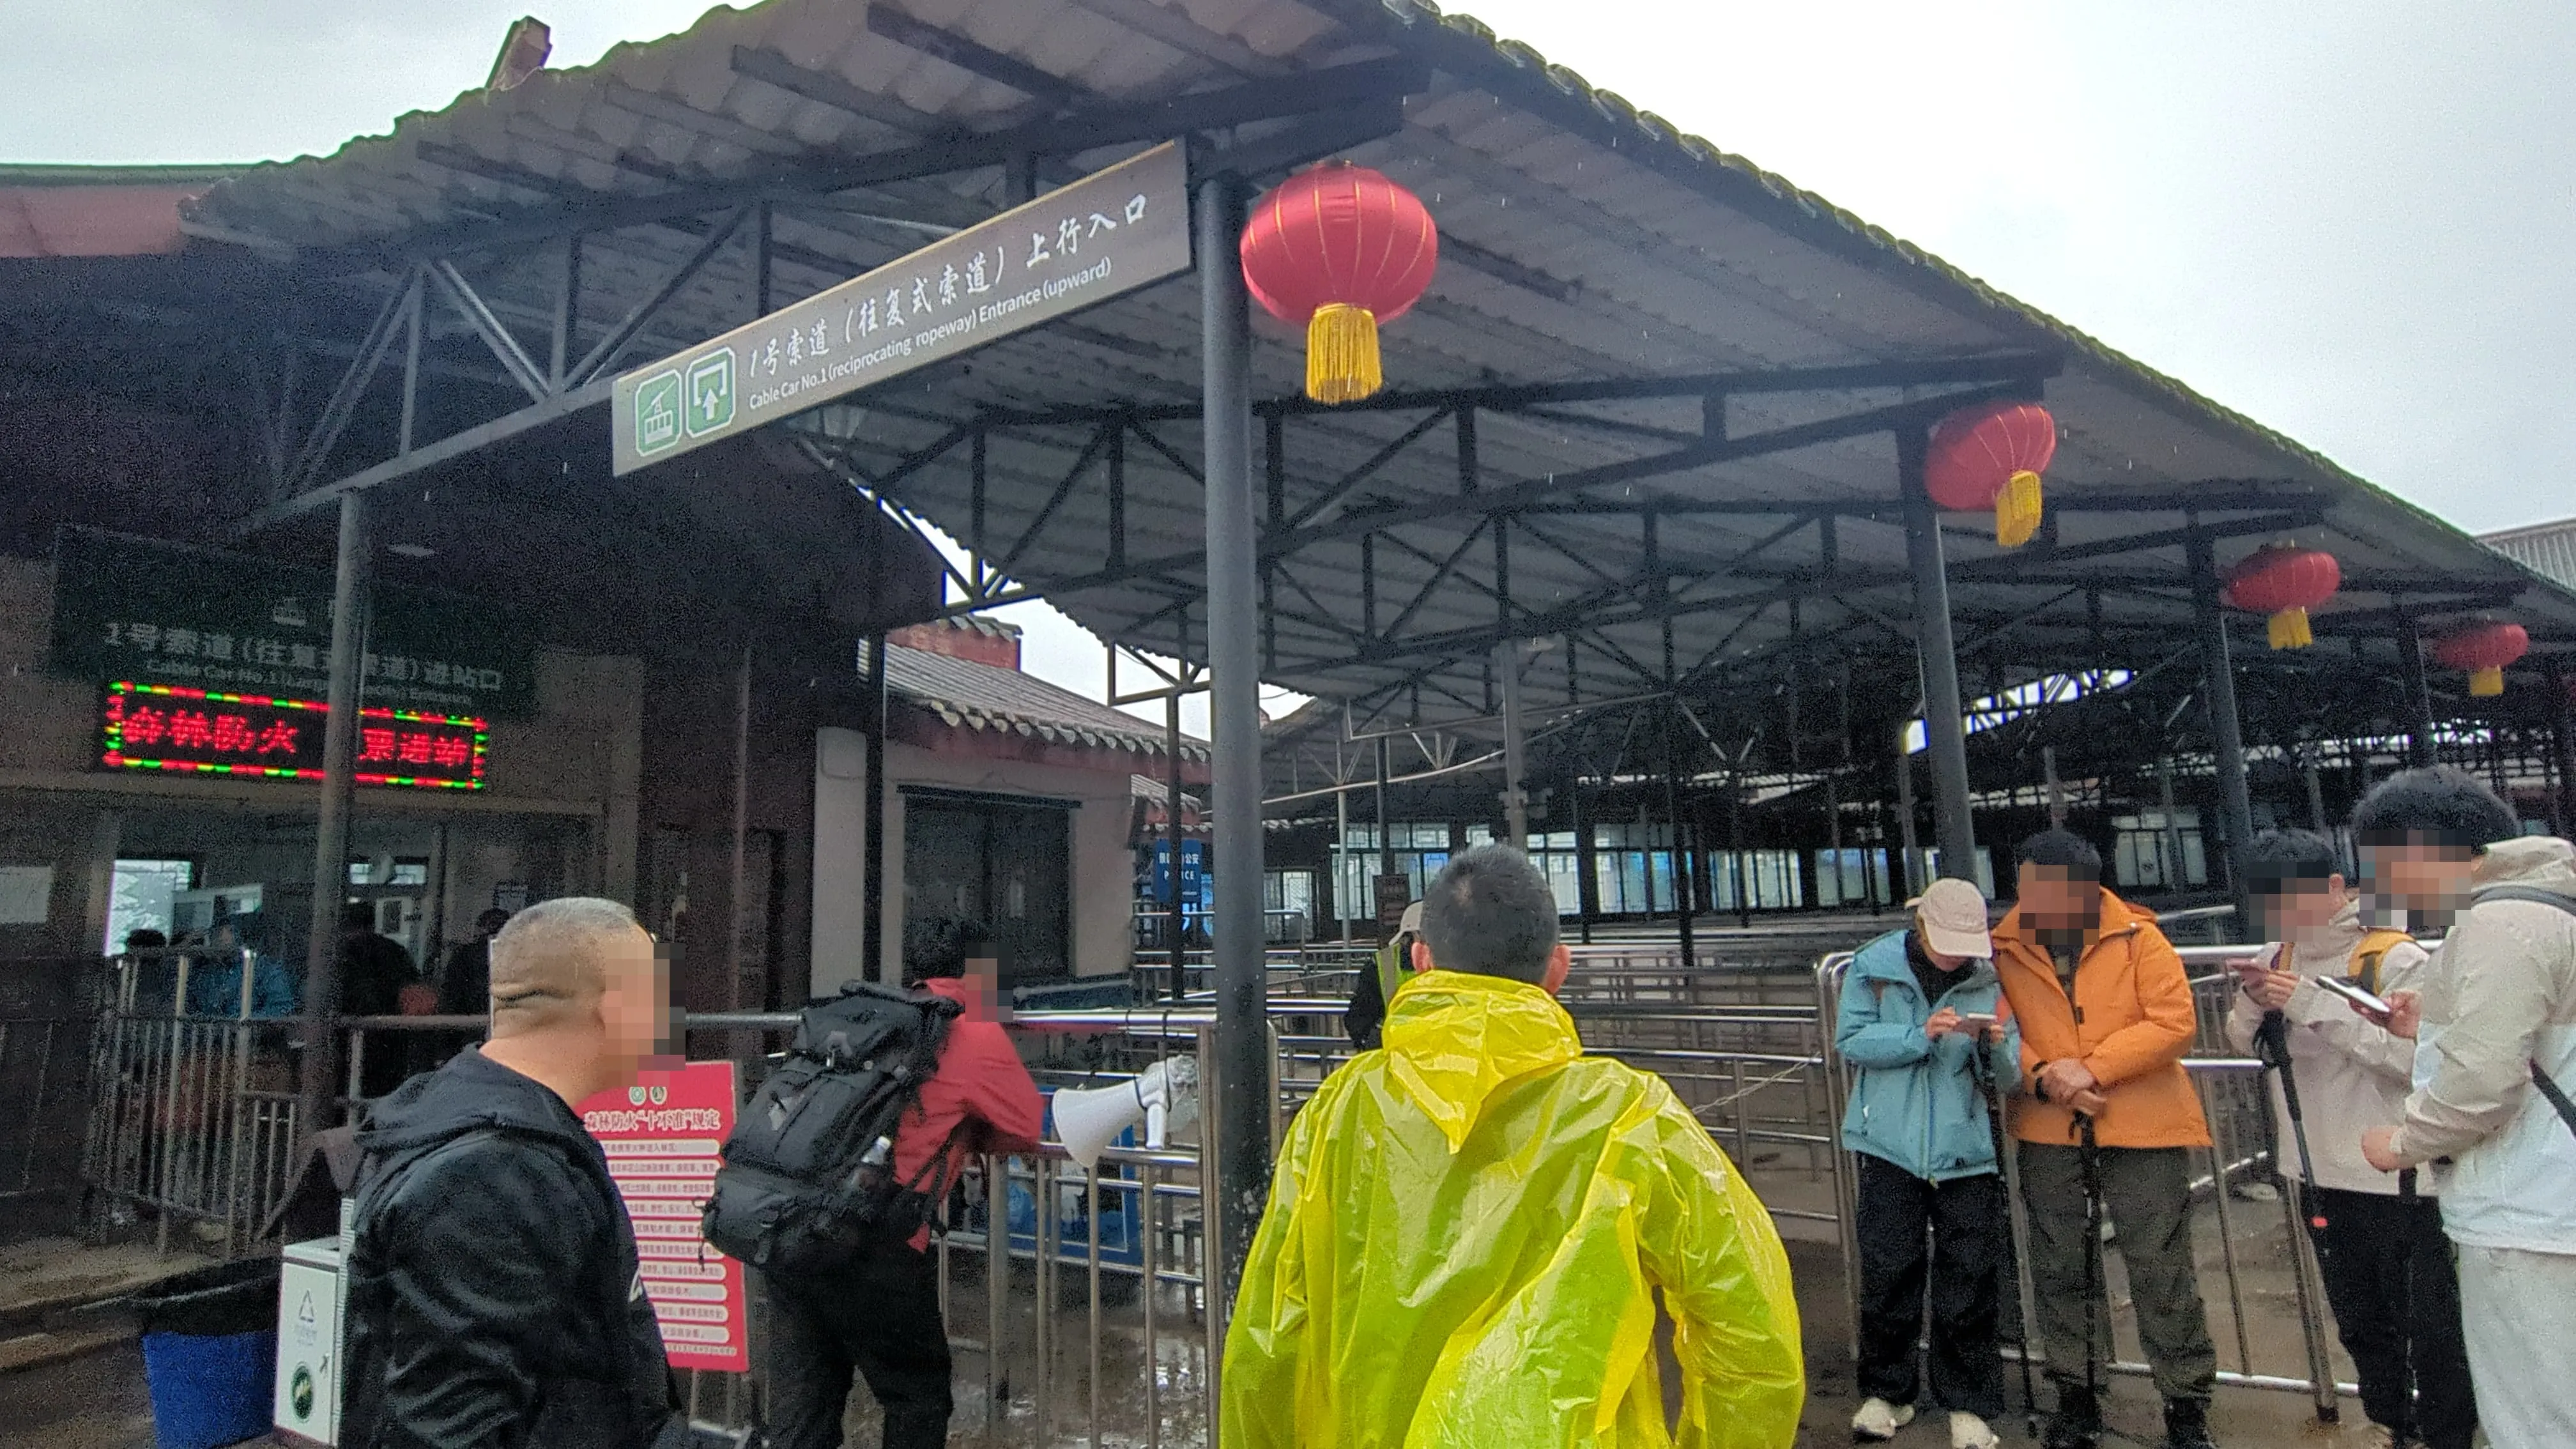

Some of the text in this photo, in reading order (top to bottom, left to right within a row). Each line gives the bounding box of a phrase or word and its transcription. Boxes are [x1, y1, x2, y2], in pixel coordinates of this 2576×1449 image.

[749, 255, 1112, 410] Cable Car No.1 (reciprocating ropeway) Entrance (upward)
[1163, 870, 1195, 880] PICE
